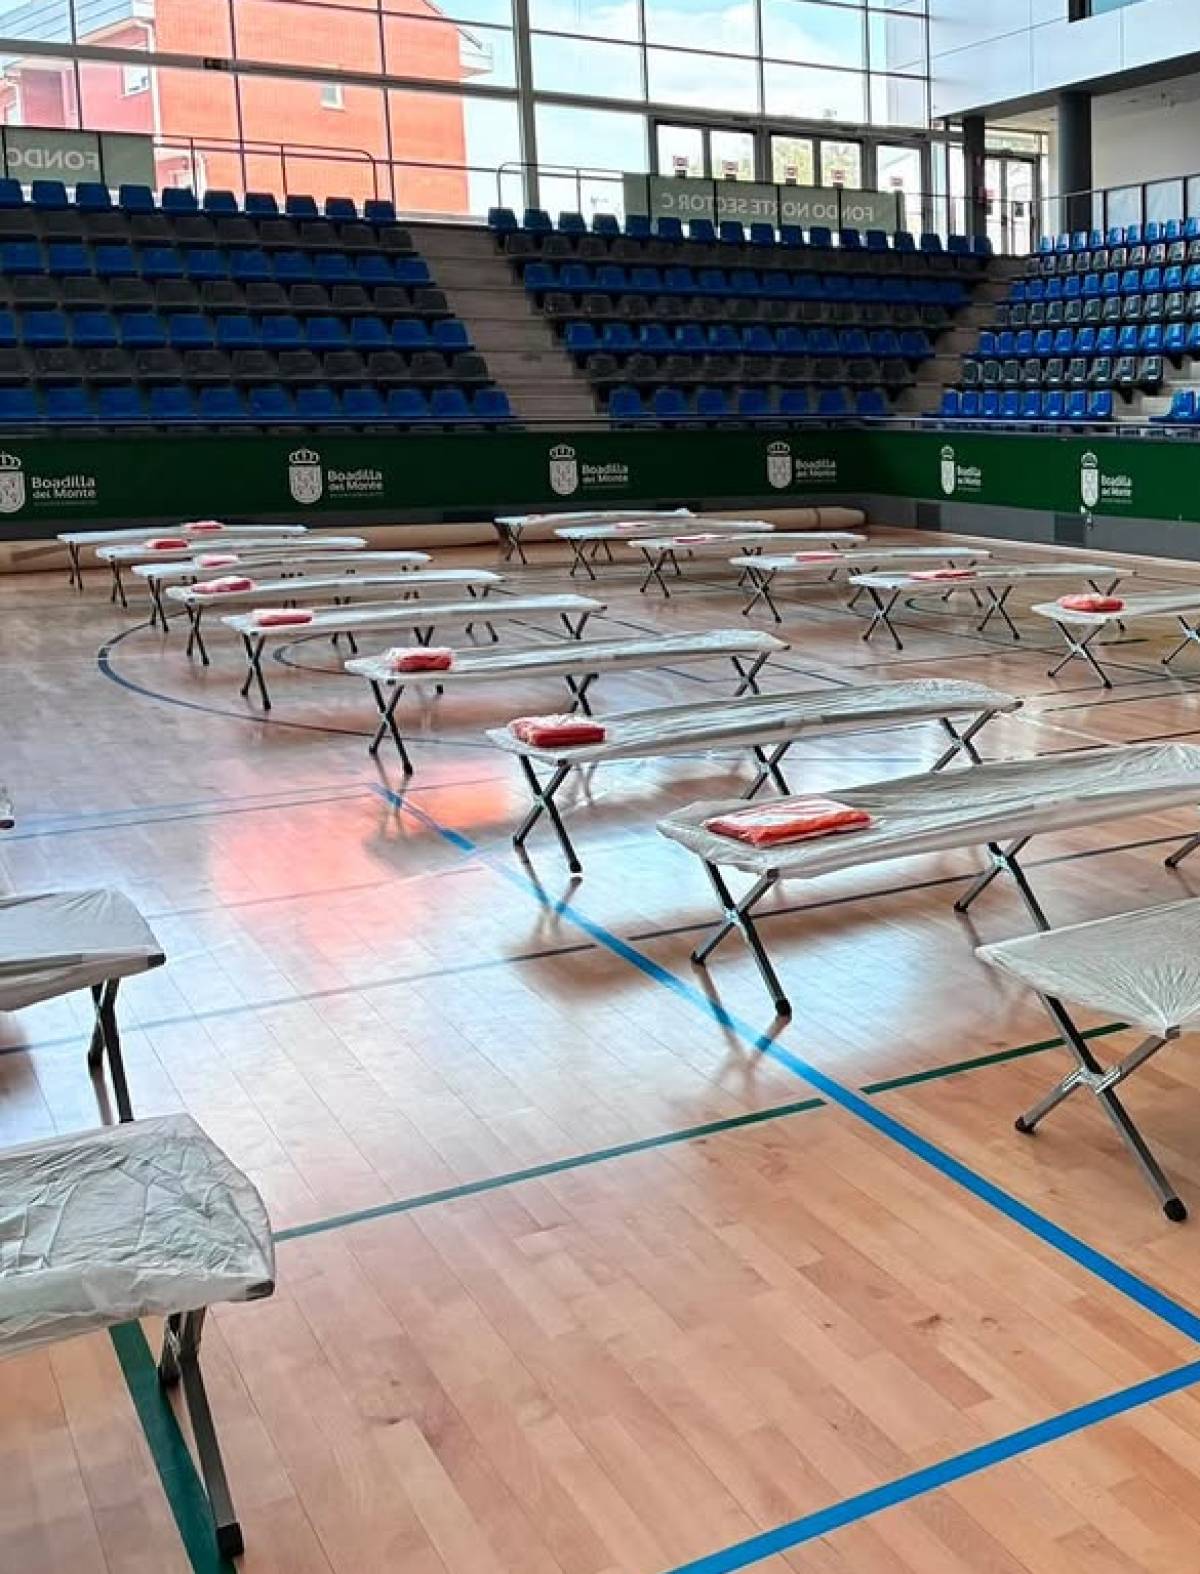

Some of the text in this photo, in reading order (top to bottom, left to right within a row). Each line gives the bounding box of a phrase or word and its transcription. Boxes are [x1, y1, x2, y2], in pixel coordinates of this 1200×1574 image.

[327, 470, 382, 480] Boadilla
[32, 476, 95, 488] Boadilla
[54, 489, 96, 498] Monte
